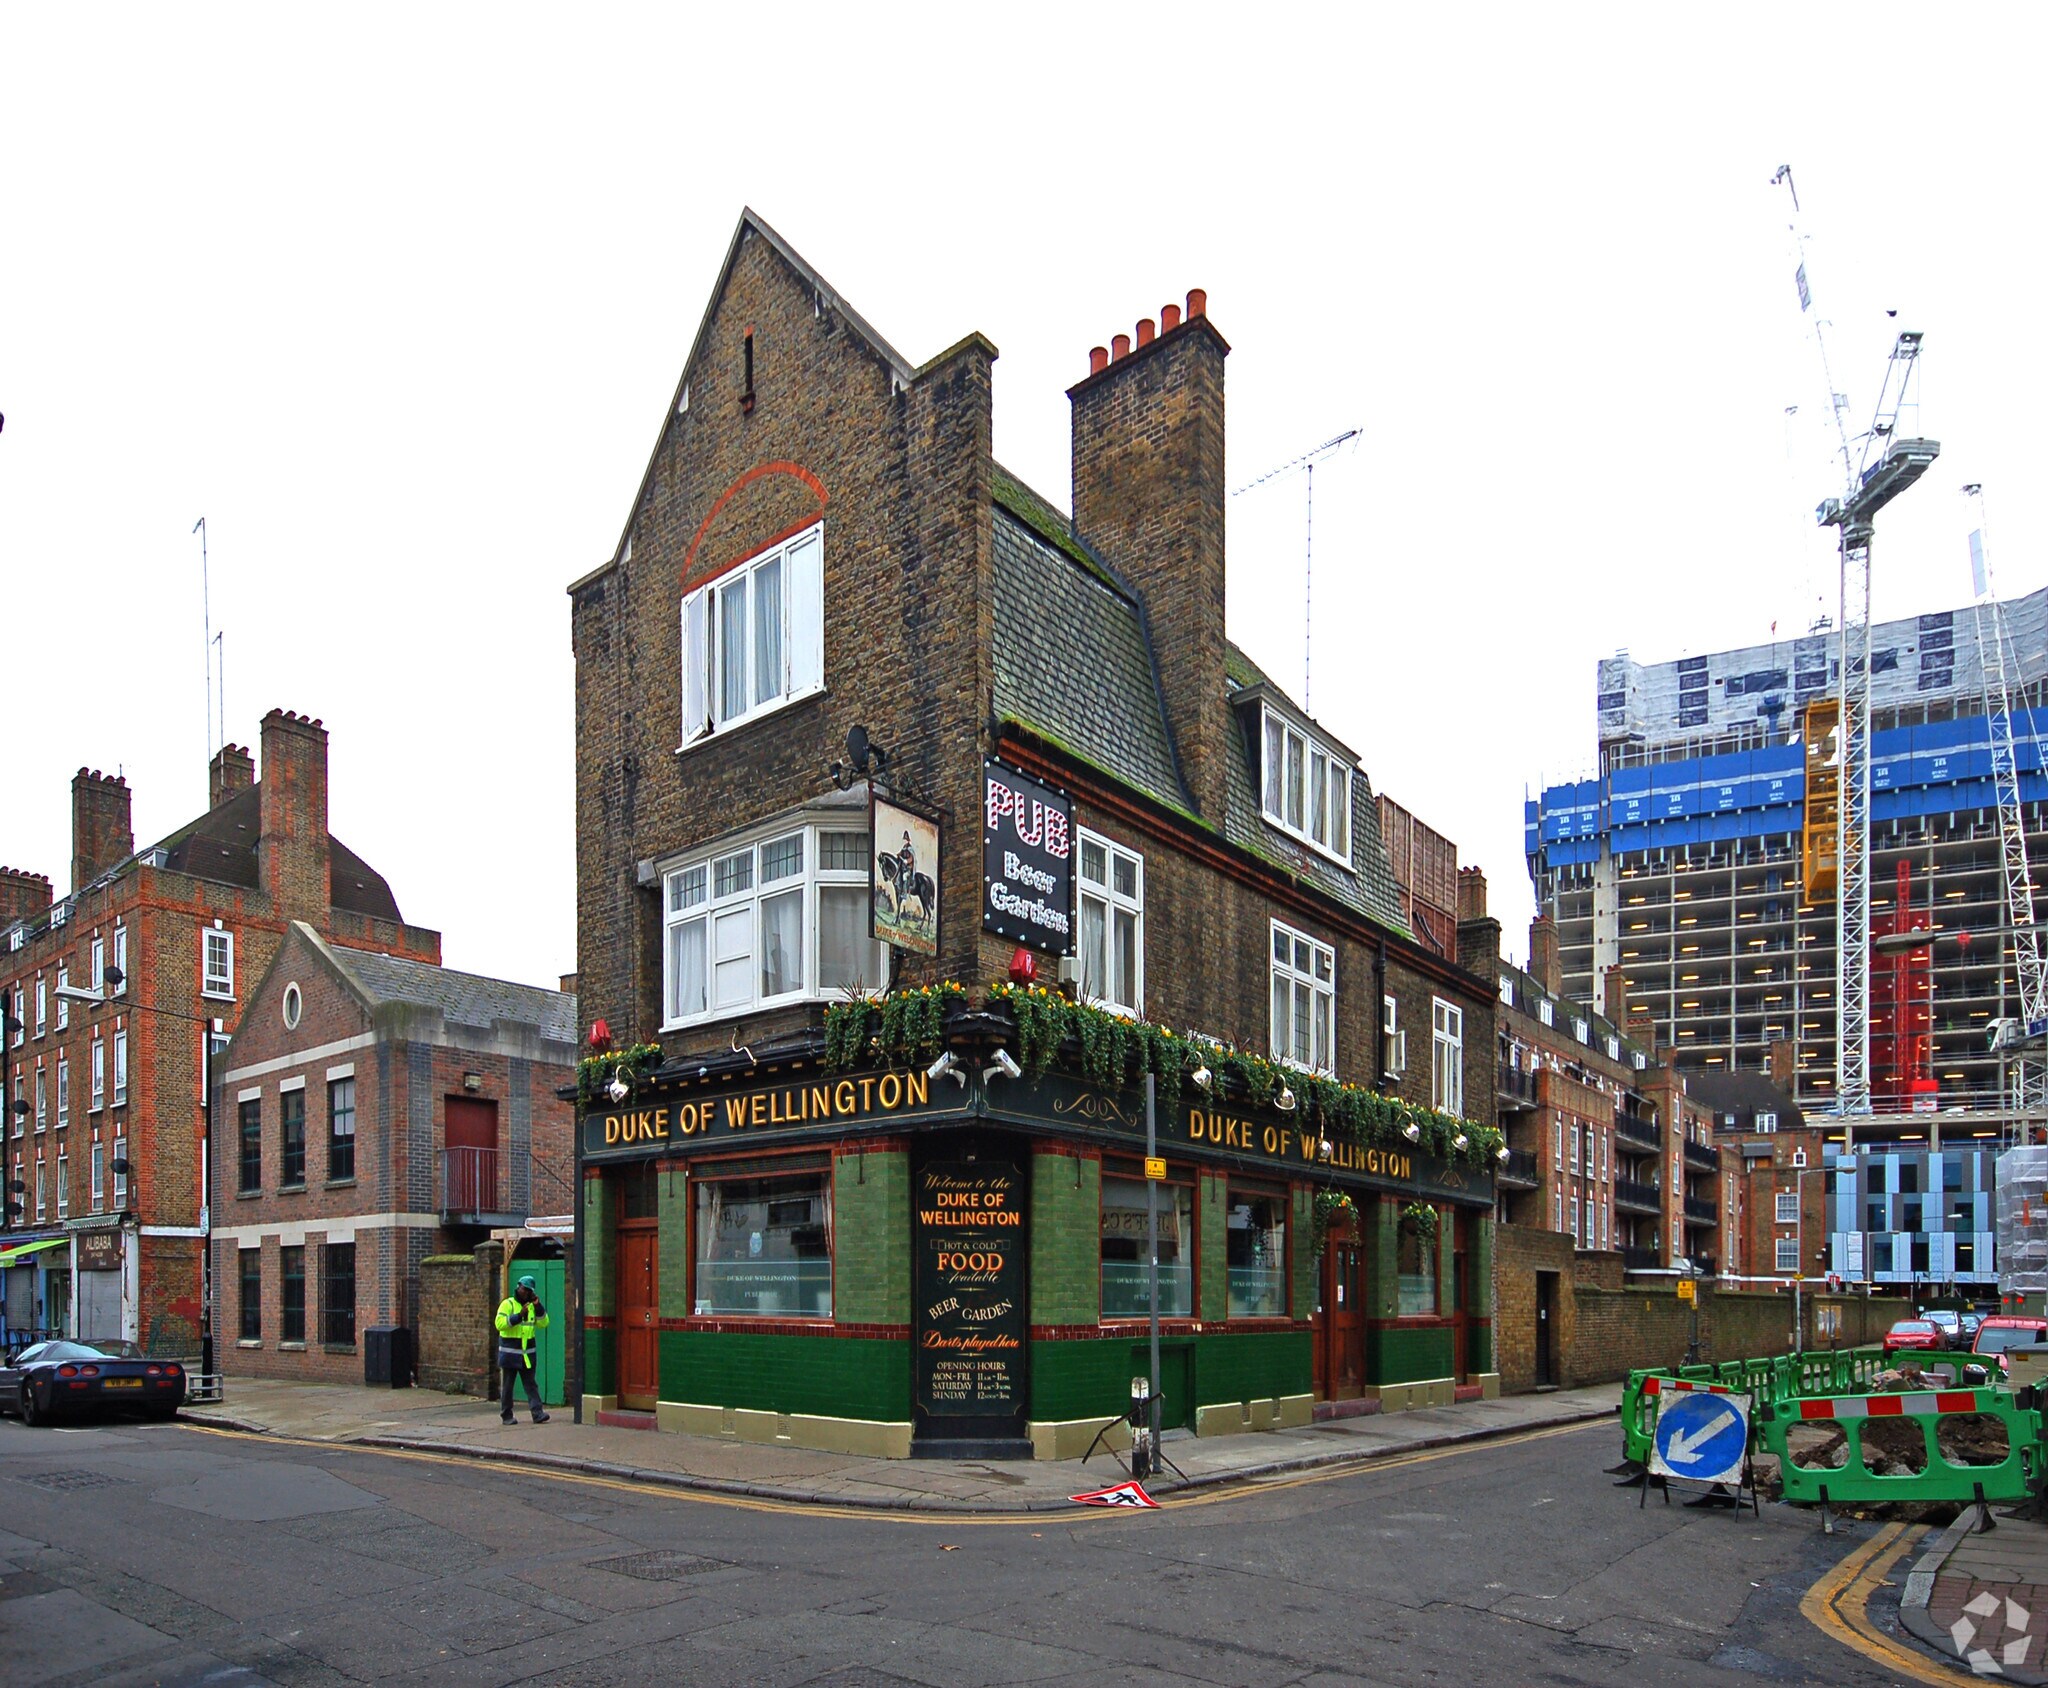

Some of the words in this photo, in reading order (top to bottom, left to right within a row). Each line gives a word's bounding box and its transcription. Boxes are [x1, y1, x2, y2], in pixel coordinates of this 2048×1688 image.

[987, 778, 1069, 858] PUB
[1004, 850, 1056, 894] Beer
[990, 882, 1069, 934] Garden
[605, 1108, 669, 1145] DUKE
[680, 1101, 715, 1135] OF
[725, 1070, 929, 1129] WELLINGTON
[1189, 1108, 1254, 1149] DUKE
[1263, 1126, 1291, 1156] OF
[924, 1174, 972, 1190] Welcome
[975, 1178, 986, 1188] to
[990, 1177, 1014, 1189] the
[937, 1193, 979, 1207] DUKE
[984, 1193, 1005, 1207] OF
[920, 1211, 1020, 1226] WELLINGTON
[944, 1241, 962, 1250] HOT
[963, 1241, 970, 1250] &
[972, 1241, 997, 1250] COLD
[937, 1252, 1004, 1271] FOOD
[937, 1271, 1000, 1285] Available
[928, 1297, 960, 1320] BEER
[962, 1299, 1013, 1321] GARDEN
[922, 1330, 961, 1349] Darts
[960, 1334, 1000, 1351] played
[998, 1334, 1019, 1348] here
[937, 1362, 976, 1370] OPENING
[977, 1362, 1006, 1370] HOURS
[932, 1382, 973, 1390] SATURDAY
